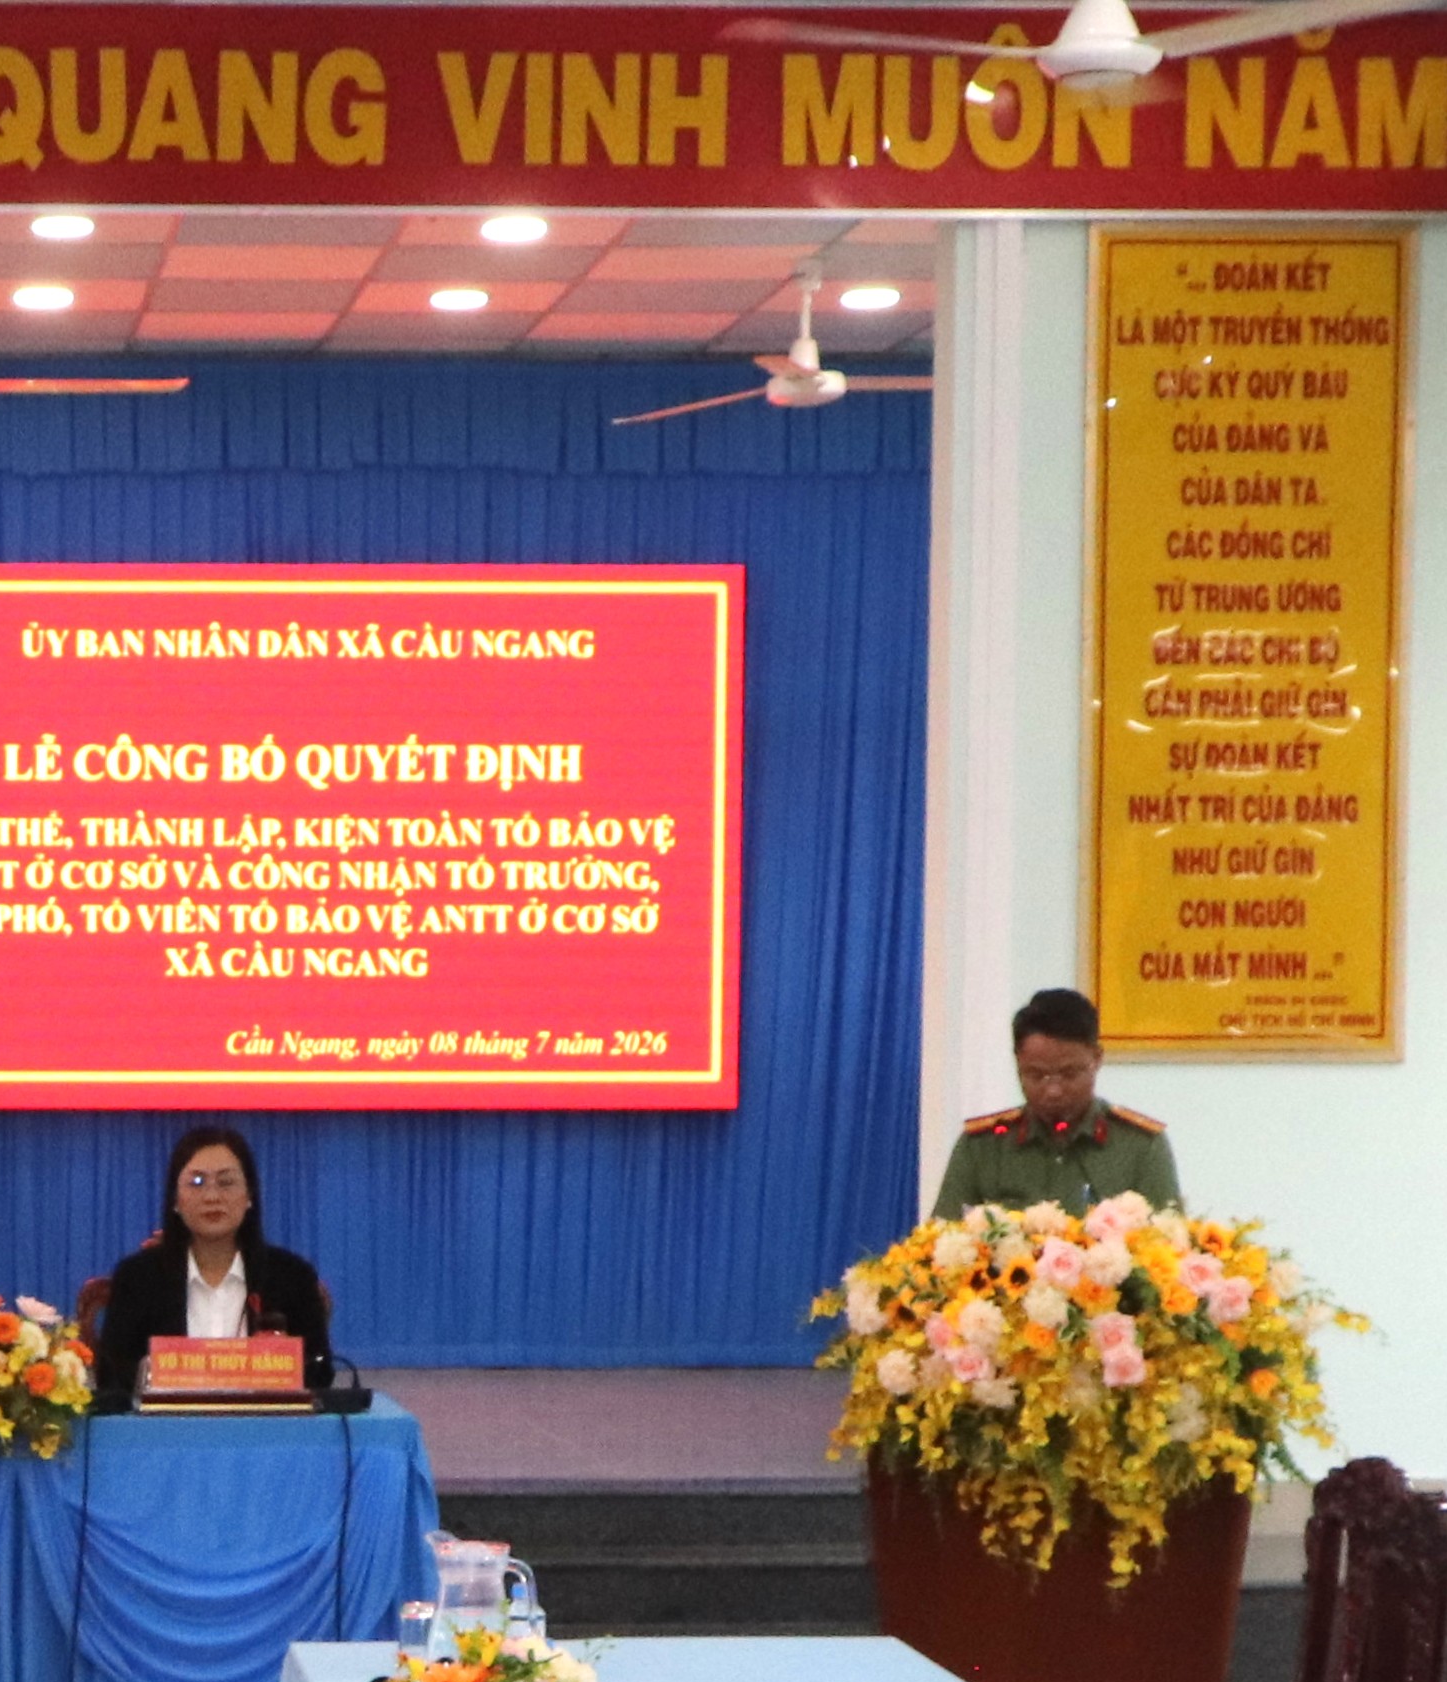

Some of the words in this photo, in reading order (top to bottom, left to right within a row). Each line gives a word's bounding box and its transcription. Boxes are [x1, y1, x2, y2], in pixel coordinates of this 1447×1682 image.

[441, 54, 727, 165] VINH
[781, 23, 1132, 171] MUÔN
[22, 621, 69, 658] ỦY
[75, 629, 145, 658] BAN
[153, 621, 250, 659] NHÂN
[257, 621, 329, 659] DÂN
[337, 623, 385, 659] XÃ
[390, 622, 463, 659] CẦU
[472, 629, 595, 659] NGANG
[4, 733, 63, 782] LỄ
[73, 733, 209, 782] CÔNG
[220, 733, 287, 782] BỐ
[295, 733, 457, 791] QUYẾT
[465, 744, 582, 792] ĐỊNH
[80, 809, 204, 847] THÀNH
[213, 814, 287, 854] LẬP,
[294, 813, 380, 854] KIỆN
[386, 810, 483, 848] TOÀN
[490, 812, 541, 848] TỔ
[548, 811, 624, 848] BẢO
[628, 814, 676, 854] VỆ
[24, 853, 55, 890] Ở
[59, 859, 115, 890] CƠ
[119, 853, 168, 890] SỞ
[172, 852, 222, 890] VÀ
[227, 852, 331, 890] CÔNG
[338, 857, 437, 896] NHẬN
[444, 855, 496, 890] TỔ
[500, 854, 660, 893] TRƯỞNG,
[80, 898, 131, 934] TỔ
[136, 896, 221, 934] VIÊN
[227, 898, 279, 934] TỔ
[286, 897, 361, 934] BẢO
[365, 900, 413, 939] VỆ
[419, 904, 514, 934] ANTT
[518, 897, 548, 934] Ở
[551, 903, 607, 934] CƠ
[611, 897, 660, 934] SỞ
[165, 941, 215, 977] XÃ
[220, 940, 295, 978] CẦU
[303, 937, 428, 977] NGANG
[226, 1024, 274, 1055] Cầu
[367, 1031, 424, 1060] ngày
[463, 1030, 529, 1060] tháng
[537, 1030, 551, 1052] 7
[554, 1031, 604, 1055] năm
[610, 1030, 667, 1056] 2026
